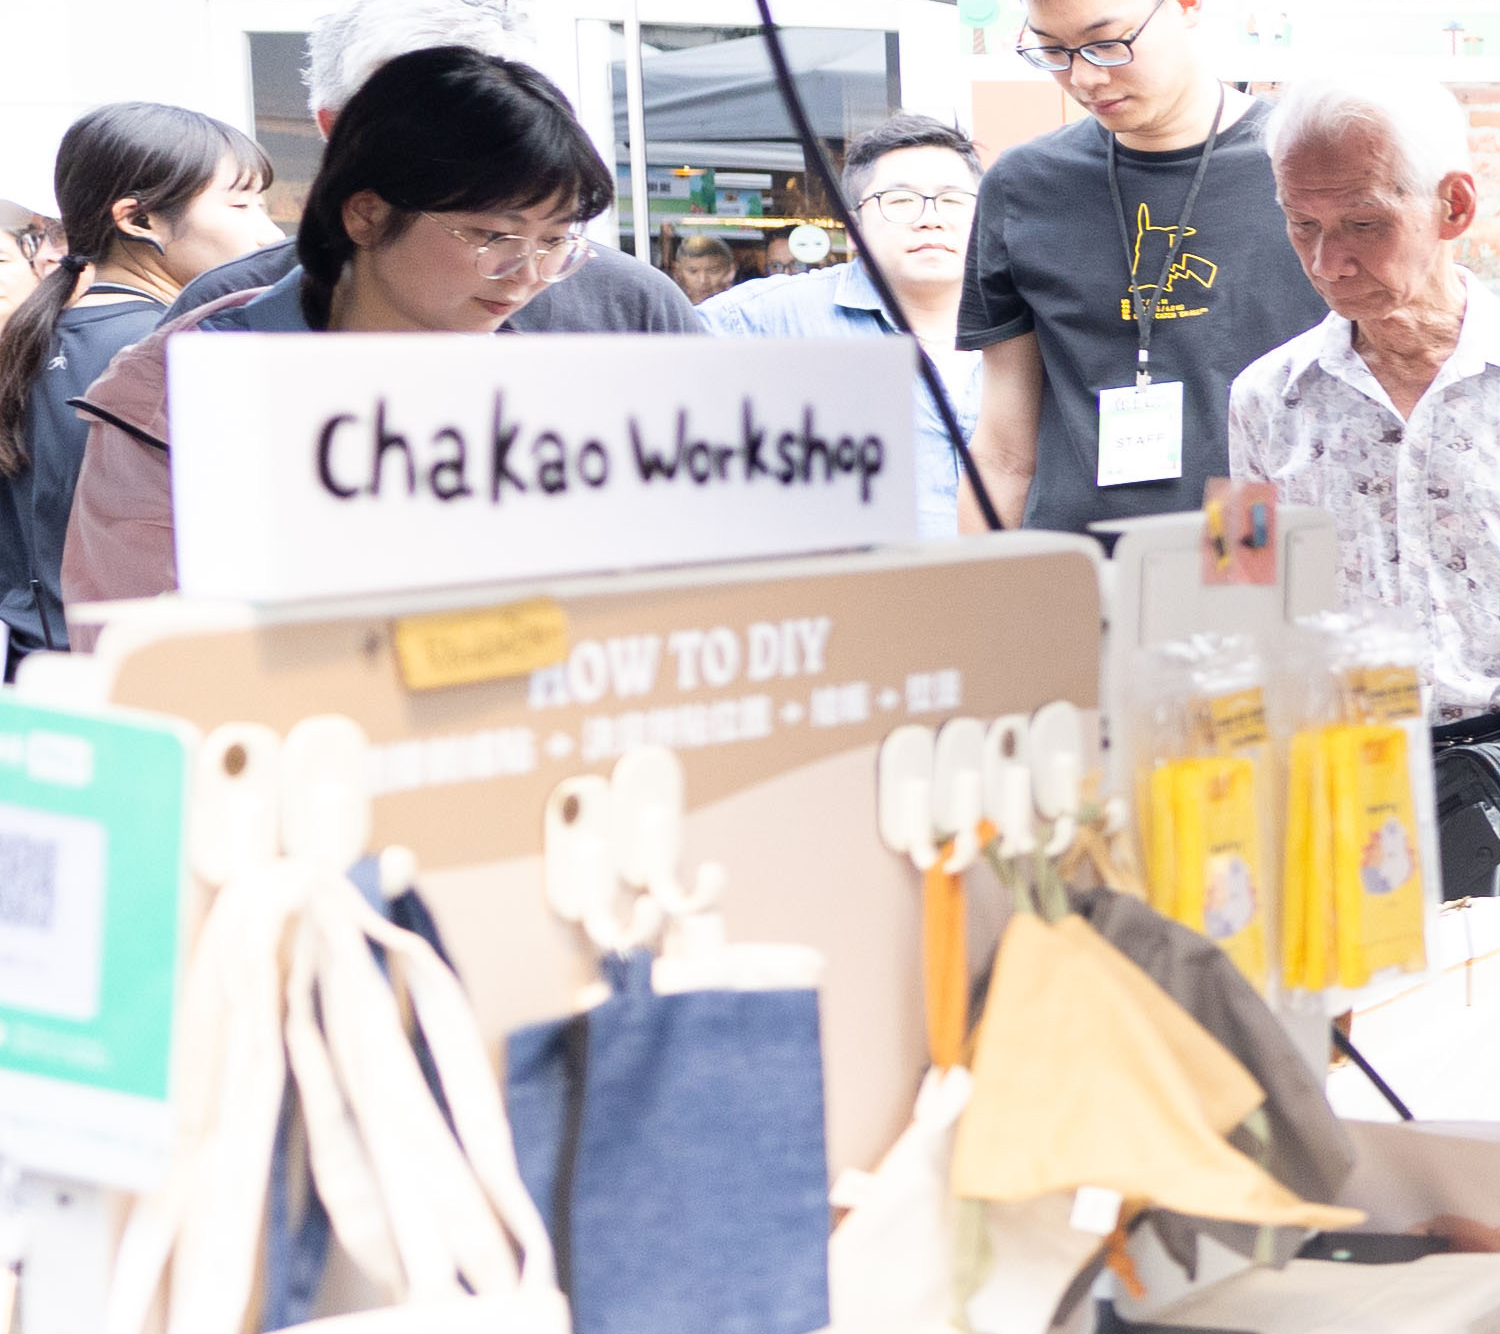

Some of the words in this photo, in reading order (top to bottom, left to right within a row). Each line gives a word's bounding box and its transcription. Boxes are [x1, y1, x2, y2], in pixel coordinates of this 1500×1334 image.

[316, 386, 609, 505] Chakao
[628, 394, 884, 505] Workshop
[668, 627, 739, 690] TO
[747, 615, 832, 681] DIY
